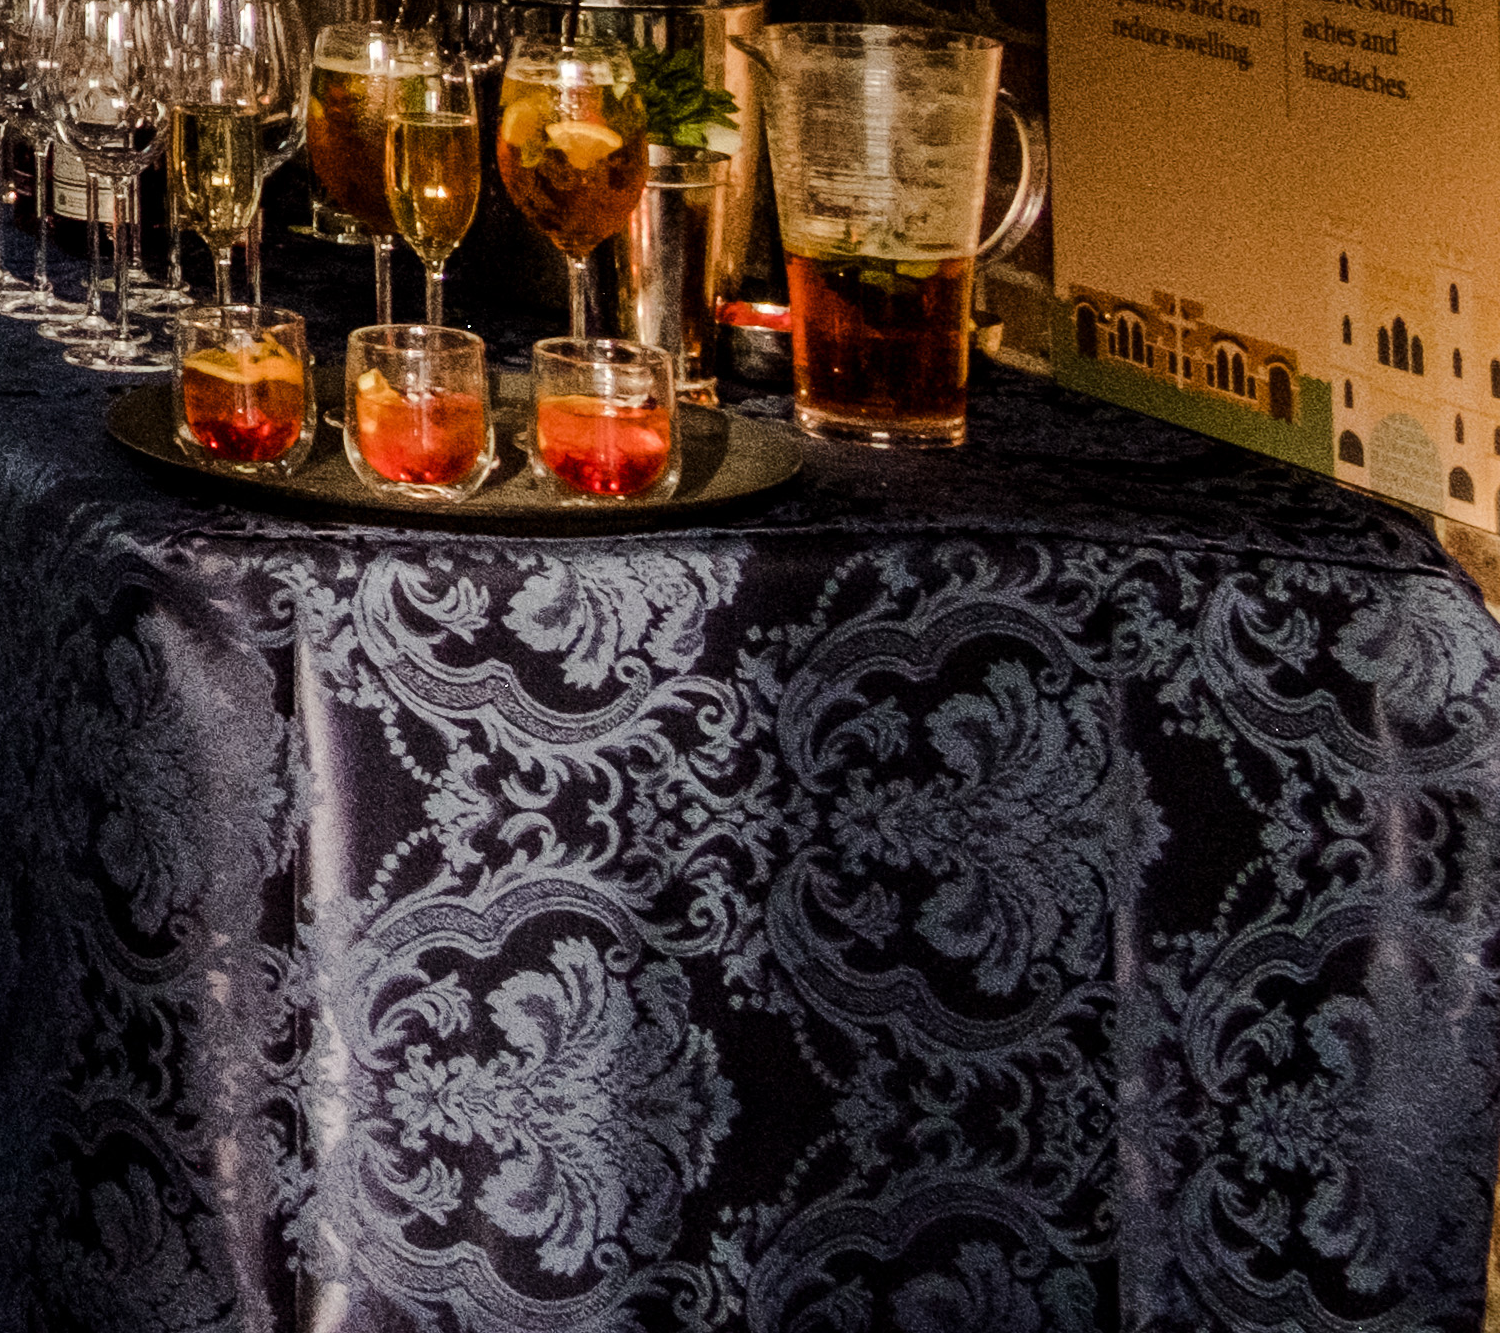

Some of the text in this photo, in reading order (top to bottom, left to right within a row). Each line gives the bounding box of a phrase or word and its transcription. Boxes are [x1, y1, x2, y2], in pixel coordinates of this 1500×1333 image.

[1227, 4, 1262, 29] can
[1301, 15, 1400, 56] aches and
[1111, 15, 1255, 72] reduce swelling.
[1302, 49, 1412, 101] headaches.
